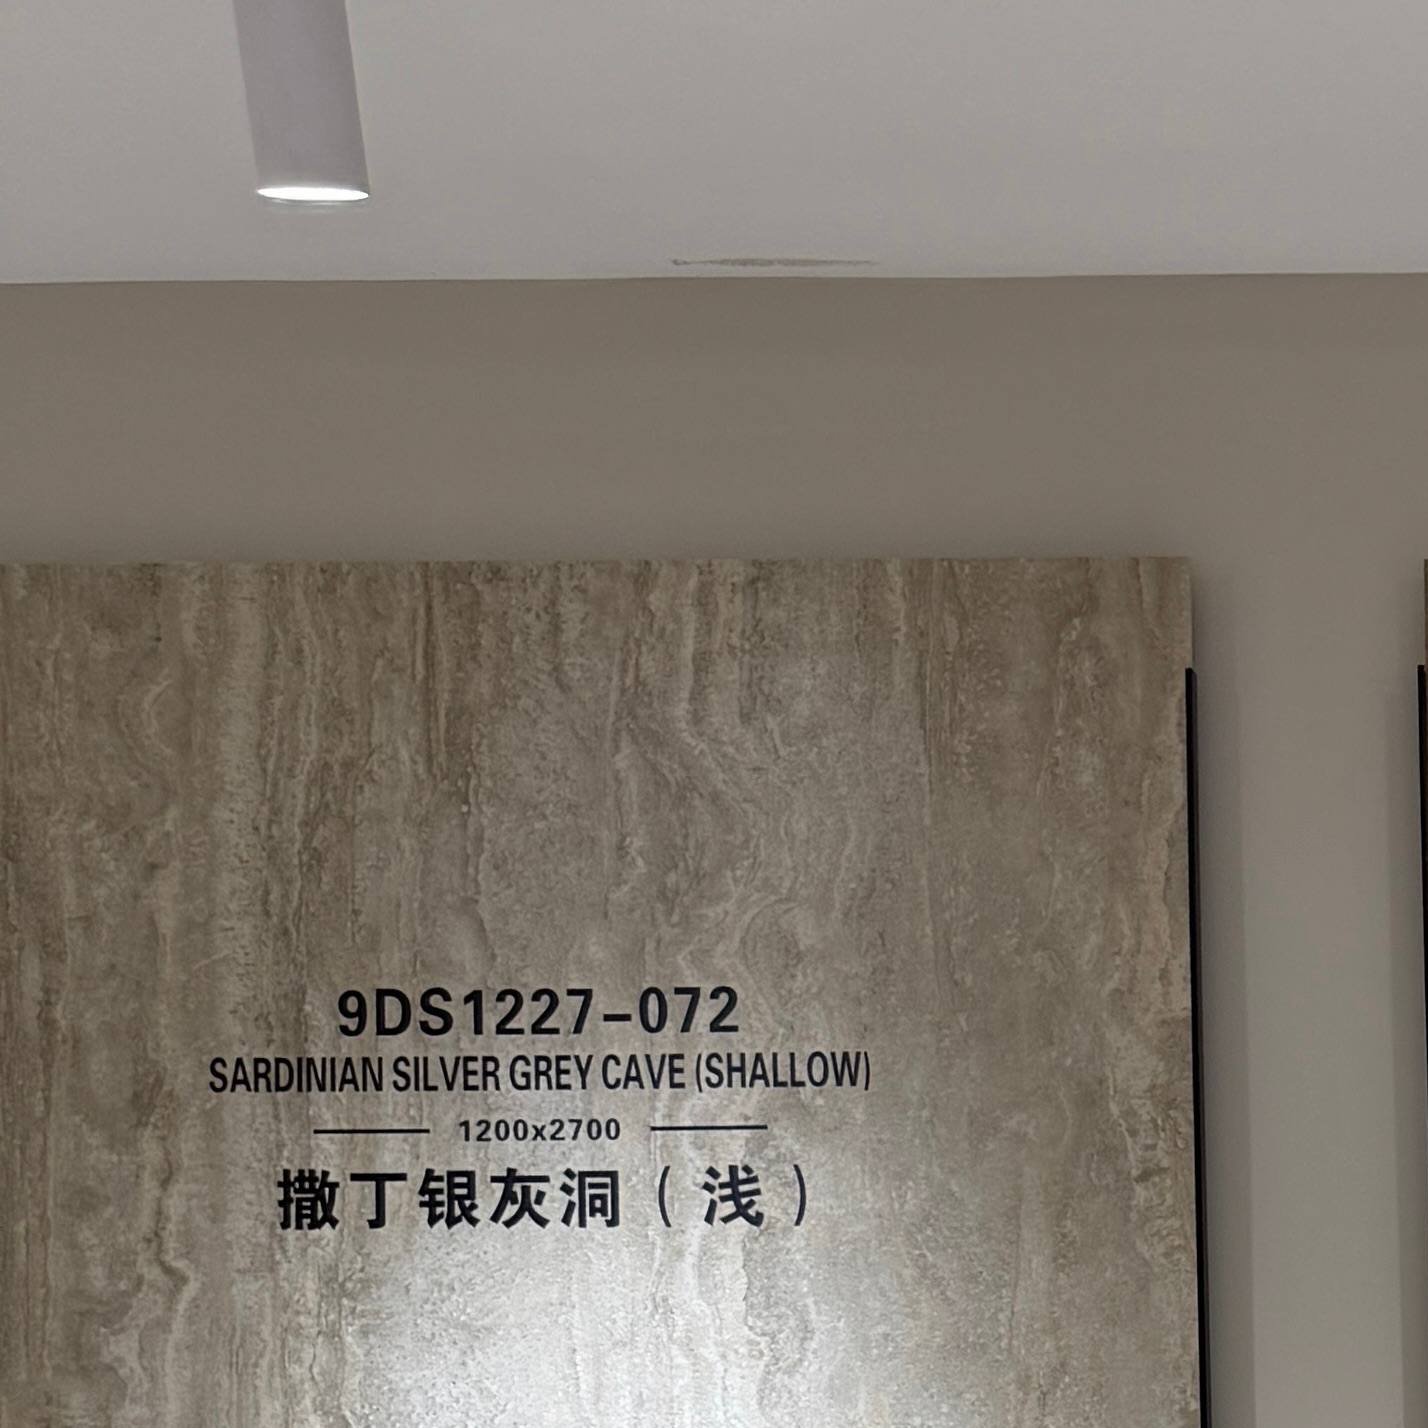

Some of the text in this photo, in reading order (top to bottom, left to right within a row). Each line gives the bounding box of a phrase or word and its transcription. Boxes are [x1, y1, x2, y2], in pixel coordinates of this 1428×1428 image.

[337, 985, 739, 1038] 9DS1227-072
[208, 1050, 872, 1094] SARDINIAN SILVER GREY CAVE (SHALLOW)
[458, 1118, 622, 1142] 1200x2700
